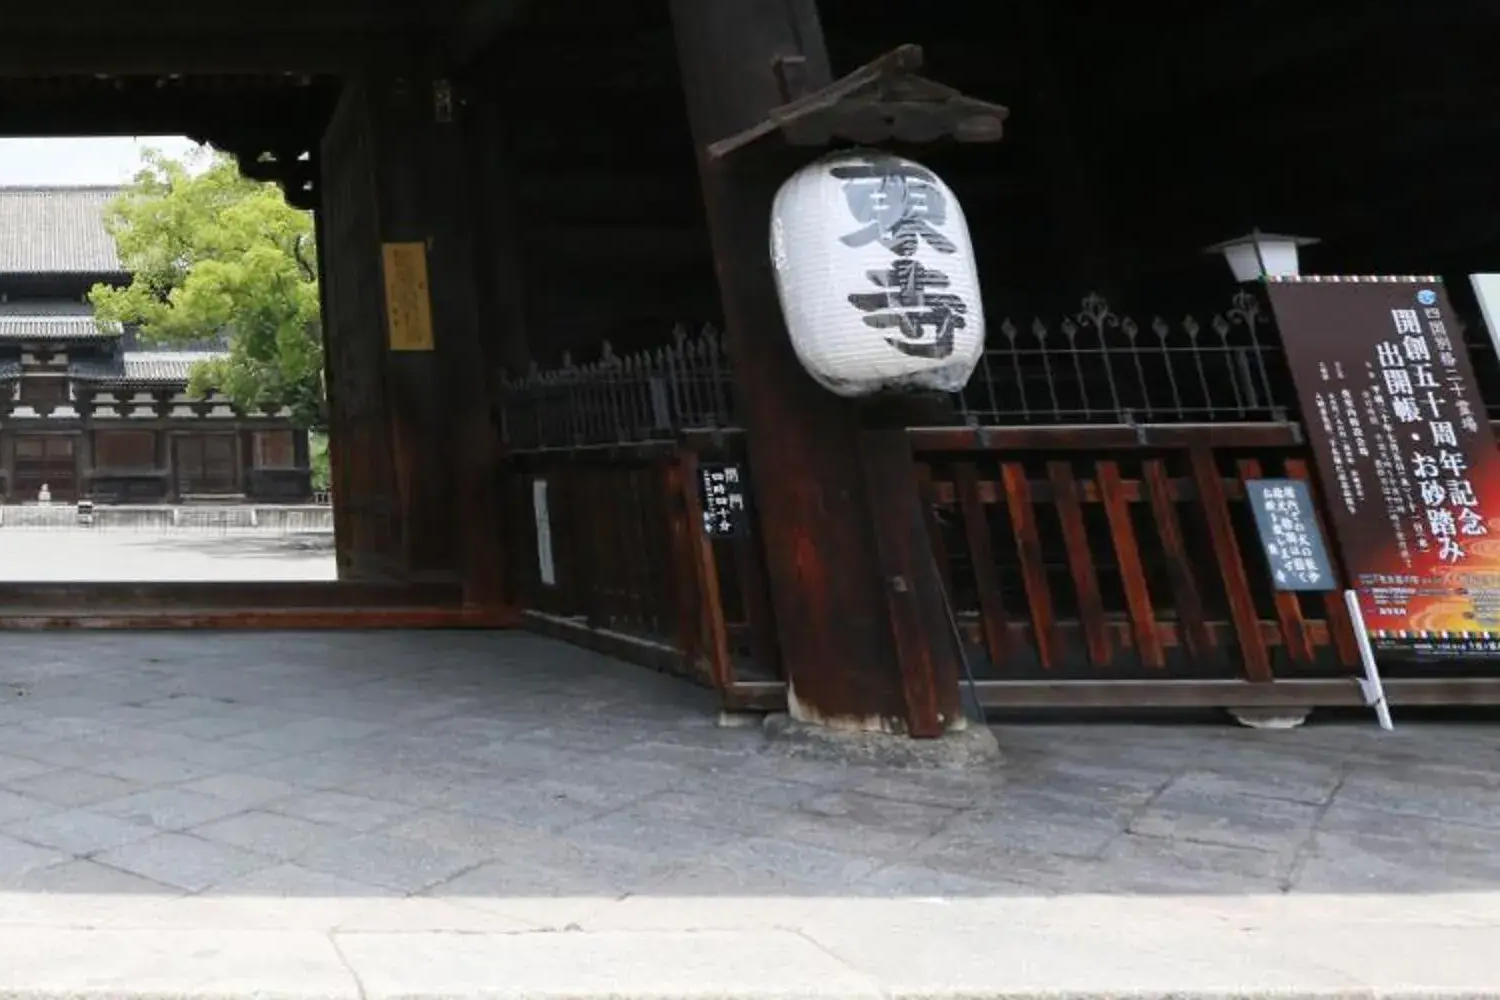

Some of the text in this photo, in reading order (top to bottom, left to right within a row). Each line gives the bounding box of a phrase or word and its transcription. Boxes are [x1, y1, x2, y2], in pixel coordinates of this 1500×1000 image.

[829, 157, 968, 360] 東寺
[1375, 340, 1465, 563] 出開帳・お砂踏み
[1391, 309, 1488, 536] 開創五十周年記念
